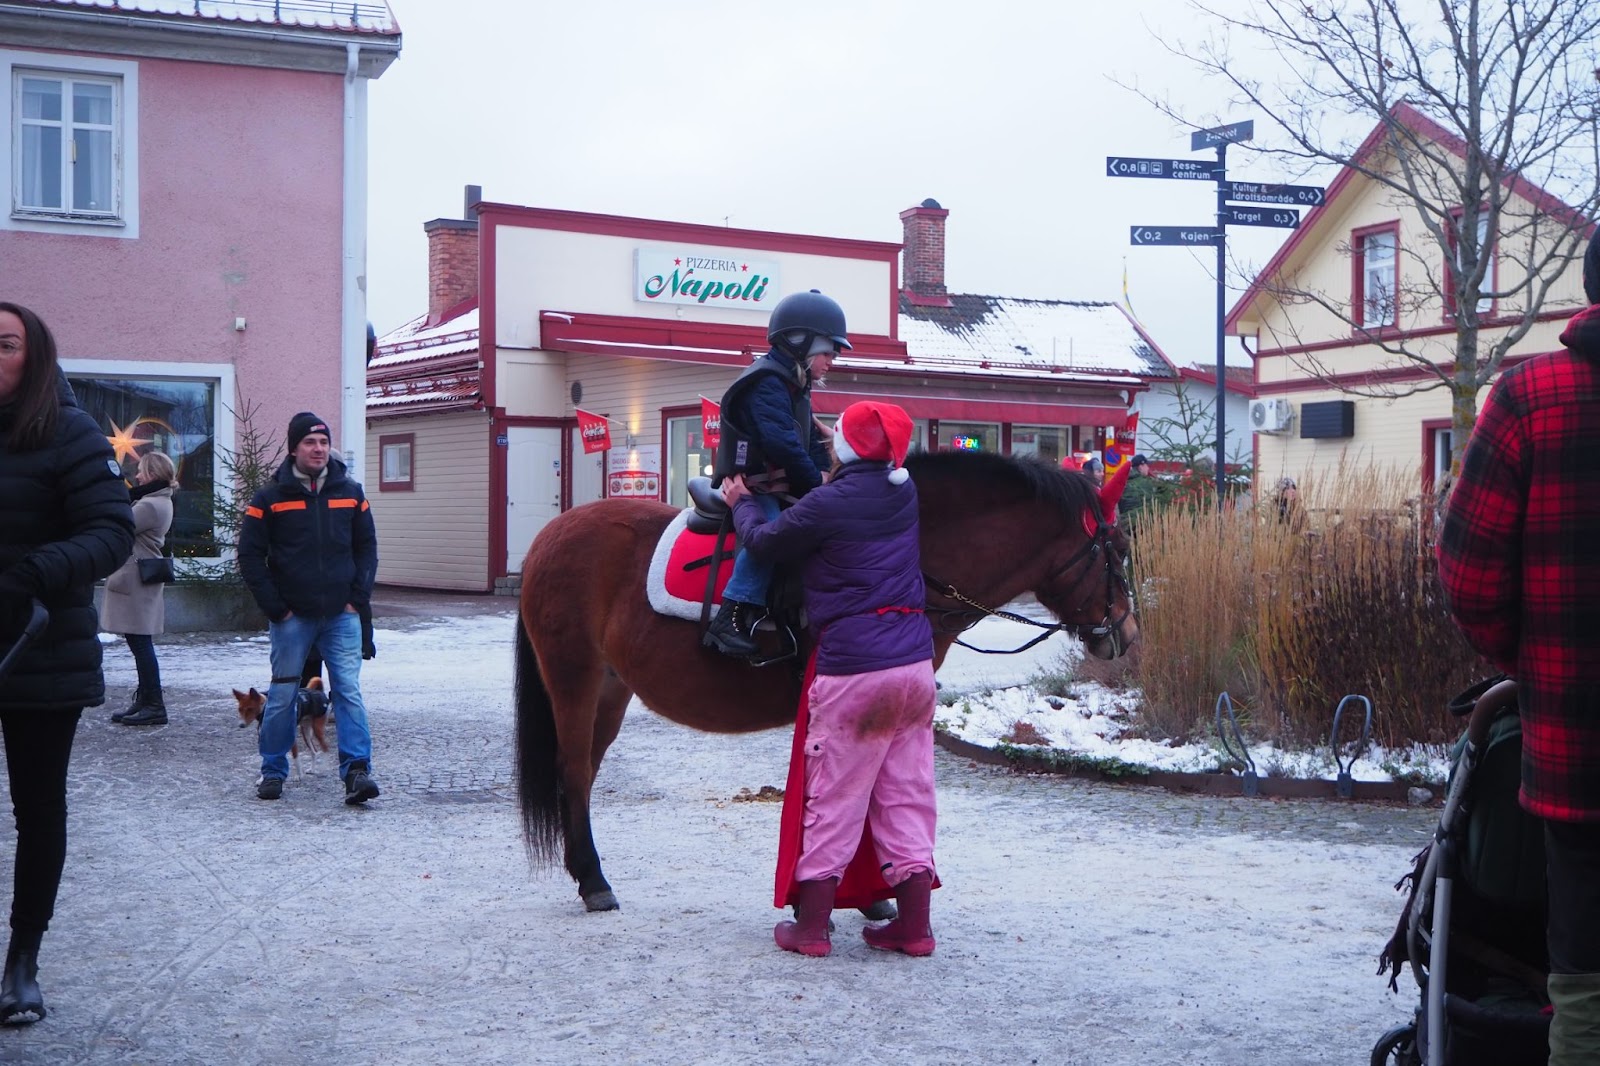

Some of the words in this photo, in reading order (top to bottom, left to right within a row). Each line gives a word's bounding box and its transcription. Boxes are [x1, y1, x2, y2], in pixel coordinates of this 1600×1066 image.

[1120, 163, 1137, 173] 0,8
[1172, 160, 1202, 170] Rese-
[1172, 171, 1211, 180] centrum
[1232, 183, 1258, 193] Kultur
[1260, 184, 1268, 193] &
[1232, 191, 1295, 204] Idrottsområde
[1299, 191, 1314, 201] 0,4
[1232, 210, 1261, 222] Torget
[1273, 213, 1289, 224] 0,3
[1144, 231, 1162, 242] 0,2
[1180, 231, 1209, 242] Kajen
[686, 257, 737, 272] PIZZERIA
[645, 268, 769, 303] Napoli
[953, 438, 979, 449] OPEN
